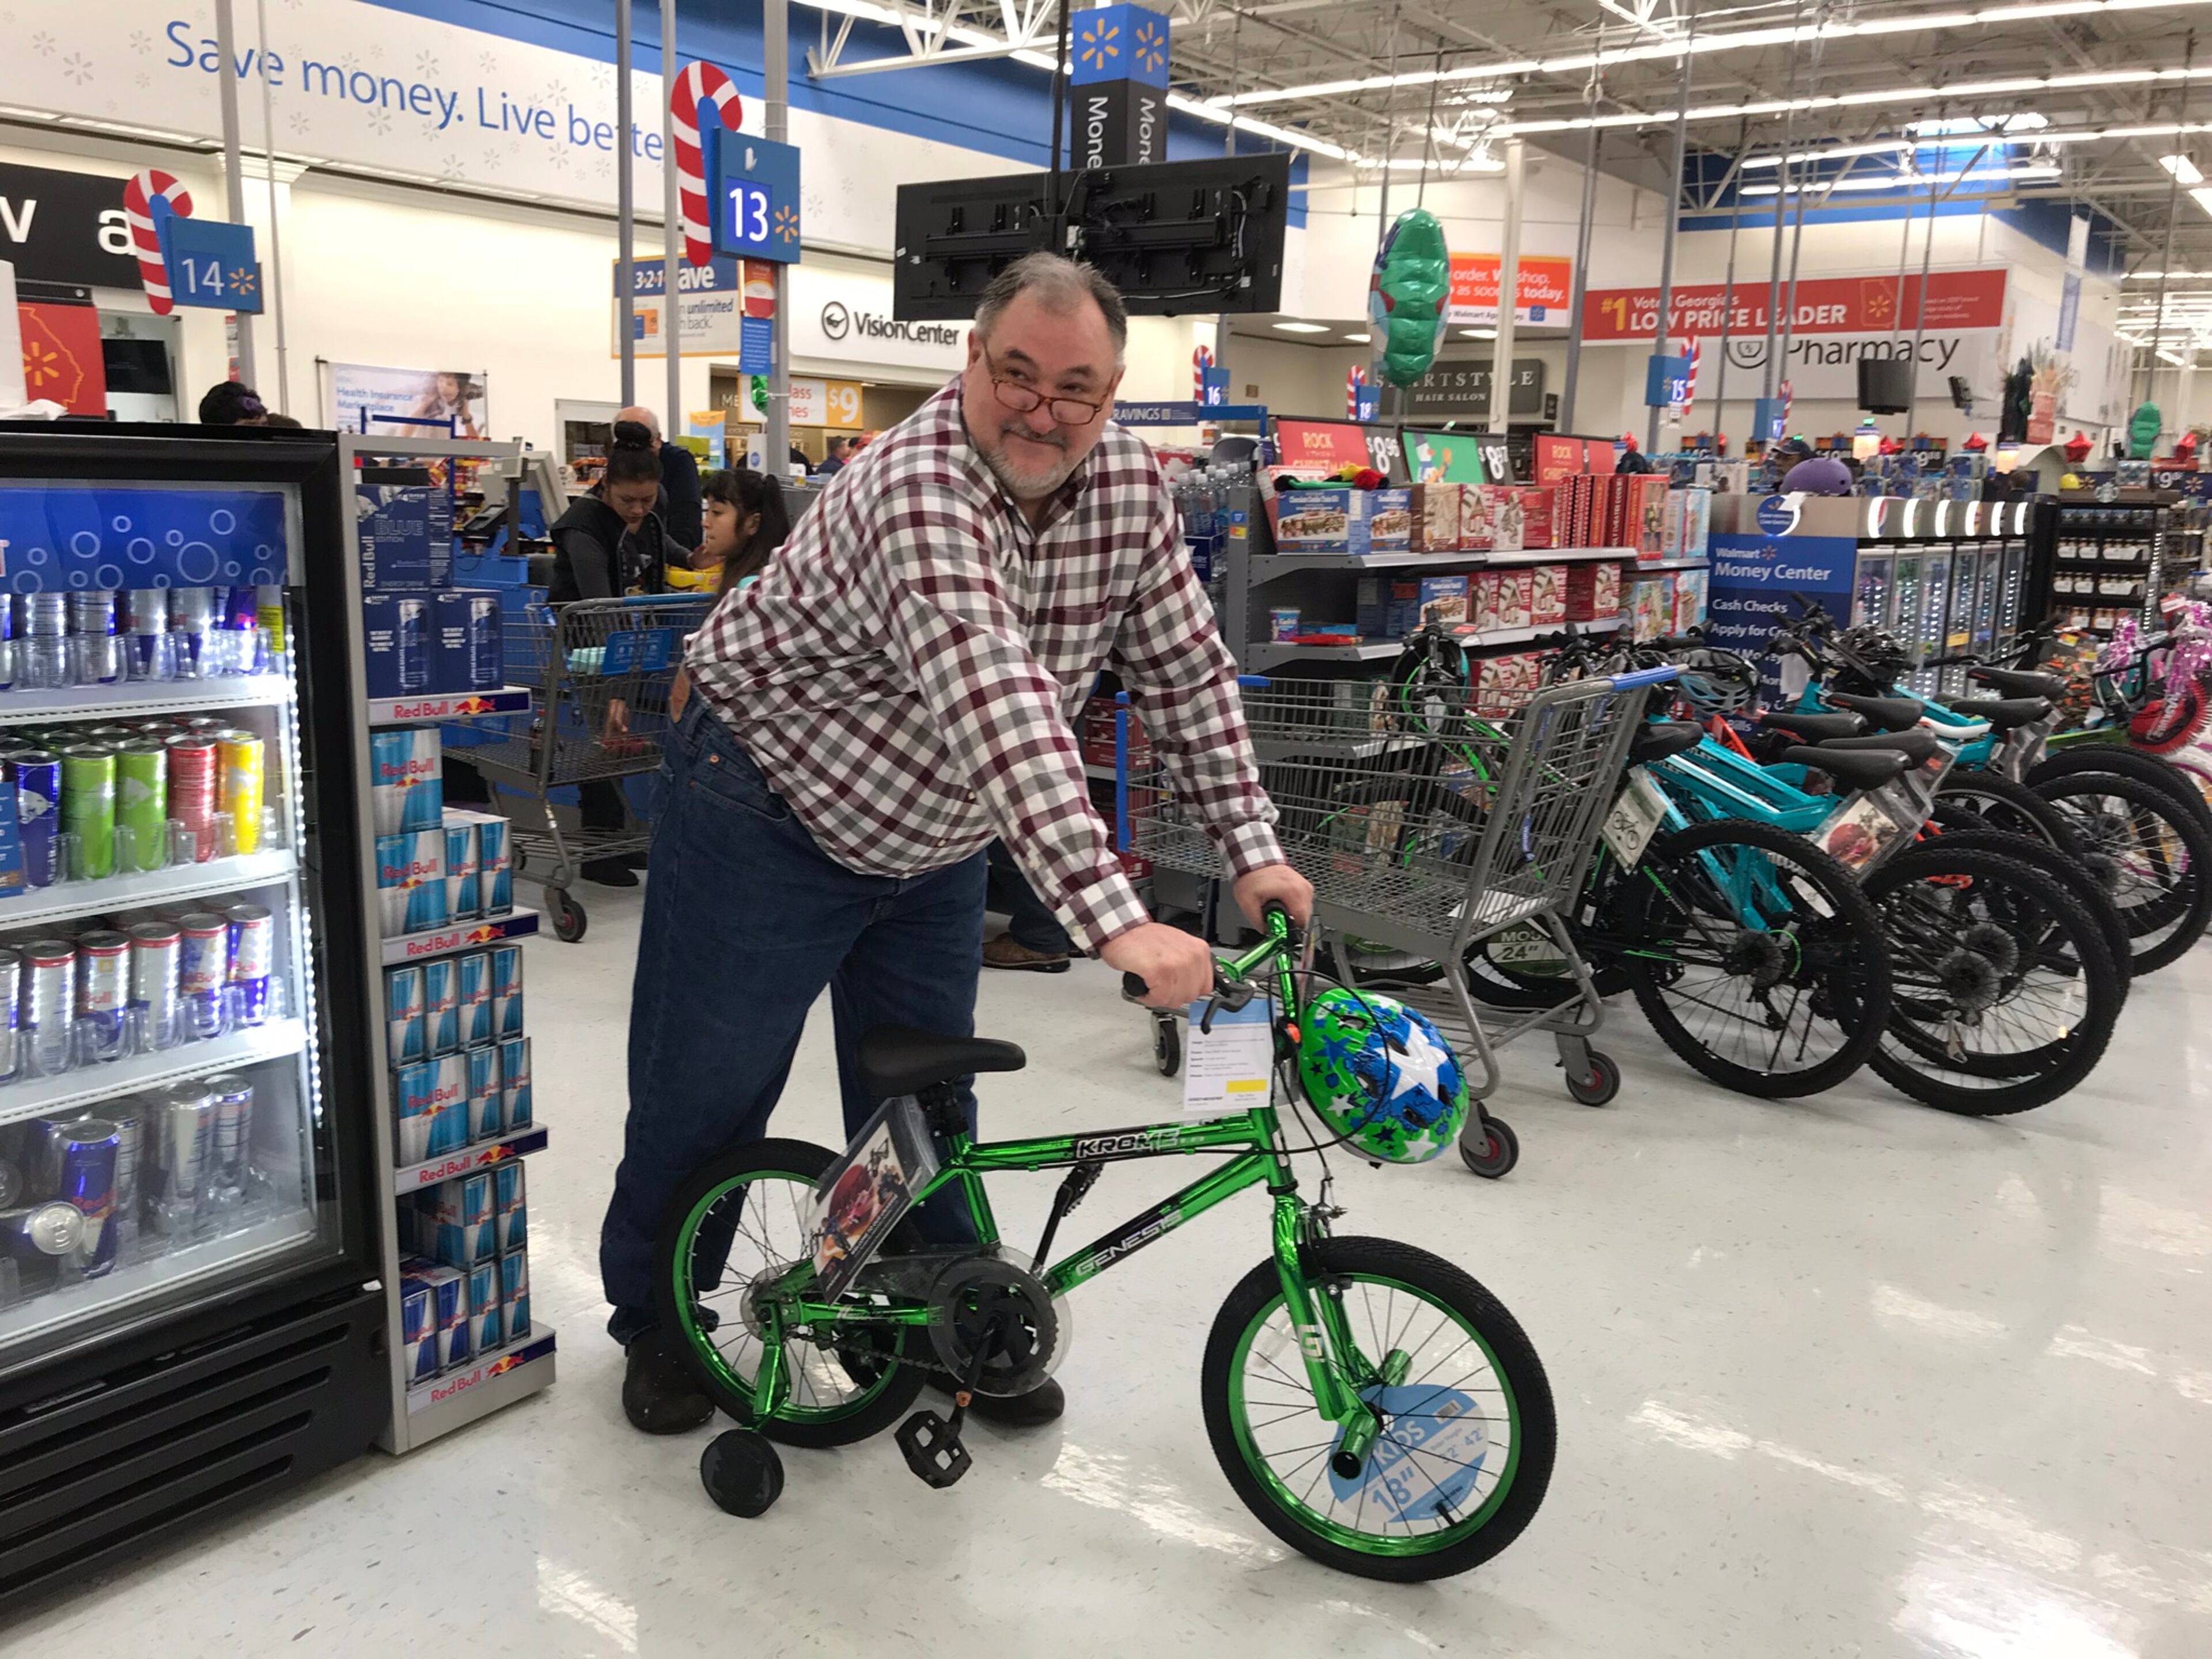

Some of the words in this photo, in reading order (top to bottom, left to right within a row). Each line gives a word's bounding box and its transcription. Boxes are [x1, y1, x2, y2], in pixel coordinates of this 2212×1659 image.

[166, 21, 285, 86] Save
[302, 60, 463, 130] money.
[478, 86, 556, 140] Live
[568, 104, 662, 162] bete
[1088, 97, 1109, 169] Mone
[1138, 97, 1156, 165] Mone
[729, 187, 770, 243] 13
[181, 258, 226, 297] 14
[1453, 267, 1490, 281] order.
[1457, 285, 1471, 296] as
[1524, 286, 1565, 302] today.
[687, 298, 734, 314] unlimited
[1601, 296, 1627, 332] #1
[1684, 308, 1751, 330] PRICE
[336, 387, 369, 398] Health
[371, 389, 414, 402] Insurance
[1207, 386, 1221, 406] 16
[1415, 393, 1444, 403] HAIR
[1448, 392, 1487, 402] SALON
[1672, 378, 1685, 402] 15
[829, 387, 859, 423] $9
[1359, 402, 1372, 419] 18
[1302, 432, 1335, 448] ROCK
[375, 520, 425, 536] BLUE
[361, 535, 376, 561] Bull
[1715, 547, 1761, 559] Walmart
[363, 562, 376, 588] Red
[1714, 562, 1772, 581] Money
[1774, 564, 1832, 581] Center
[1712, 599, 1741, 611] Cash
[1743, 600, 1788, 613] Checks
[1710, 623, 1747, 638] Apply
[1748, 624, 1767, 636] for
[393, 703, 421, 719] Red
[423, 700, 449, 715] Bull
[381, 760, 407, 777] Red
[410, 757, 434, 773] Bull
[382, 864, 410, 879] Red
[412, 858, 438, 875] Bull
[407, 938, 433, 956] Red
[434, 933, 460, 950] Bull
[407, 1093, 433, 1108] Red
[435, 1083, 458, 1101] Bull
[419, 1164, 445, 1183] Red
[446, 1156, 471, 1175] Bull
[1076, 1209, 1184, 1276] GENESIS
[430, 1382, 455, 1402] Red
[457, 1369, 480, 1392] Bull
[1376, 1420, 1426, 1466] KIDS
